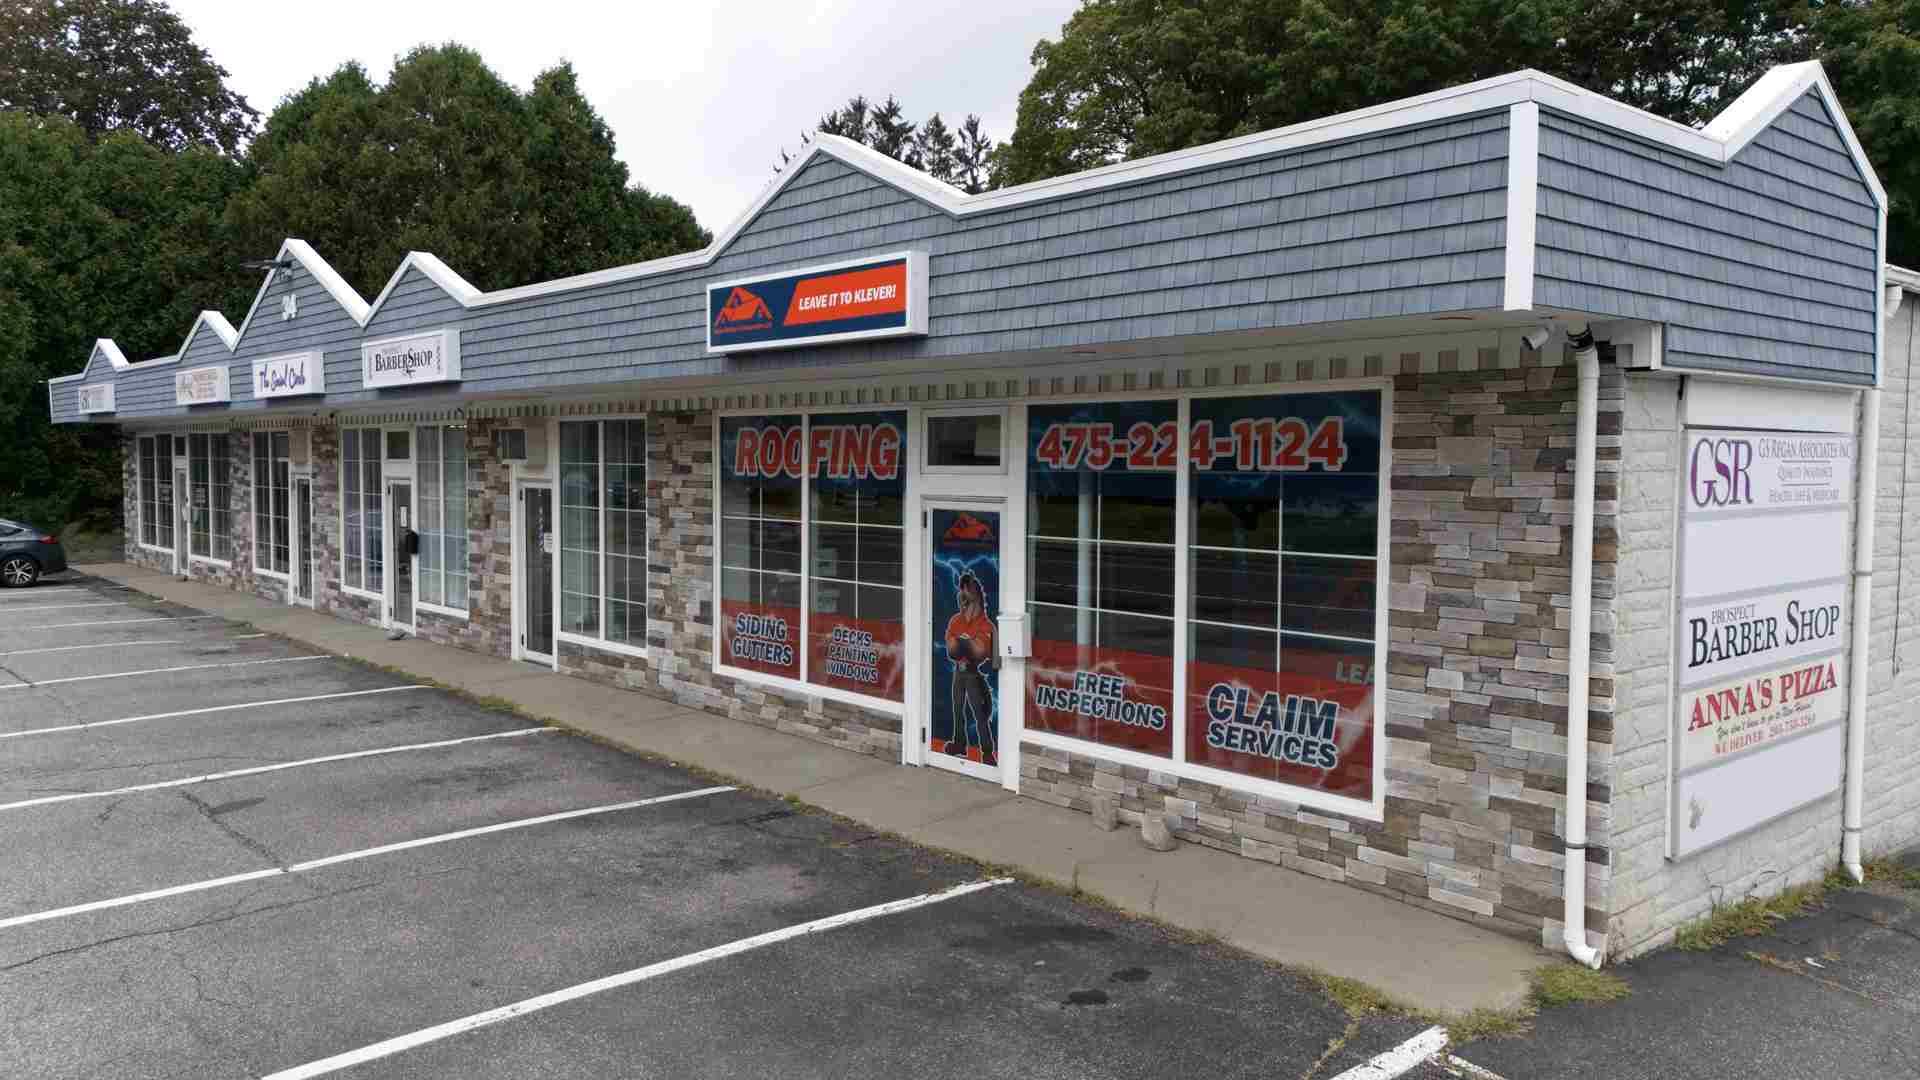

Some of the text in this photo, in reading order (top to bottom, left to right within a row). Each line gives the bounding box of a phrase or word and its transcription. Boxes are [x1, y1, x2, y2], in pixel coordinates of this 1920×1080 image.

[798, 284, 897, 311] LEAVE IT TO KLEVER!
[735, 424, 900, 480] ROOFING
[1036, 416, 1348, 472] 475-224-1124
[1690, 437, 1754, 508] GSR
[736, 614, 787, 640] SIDING
[1711, 605, 1756, 625] PROSPECT
[731, 637, 793, 666] GUTTERS
[832, 627, 872, 648] DECKS
[1688, 600, 1840, 668] BARBER SHOP
[824, 661, 879, 684] WINDOWS
[827, 645, 877, 665] PAINTING
[1075, 671, 1124, 697] FREE
[1688, 661, 1838, 732] ANNA'S PIZZA
[1036, 685, 1167, 730] INSPECTIONS
[1207, 684, 1339, 740] CLAIM
[1206, 721, 1339, 770] SERVICES
